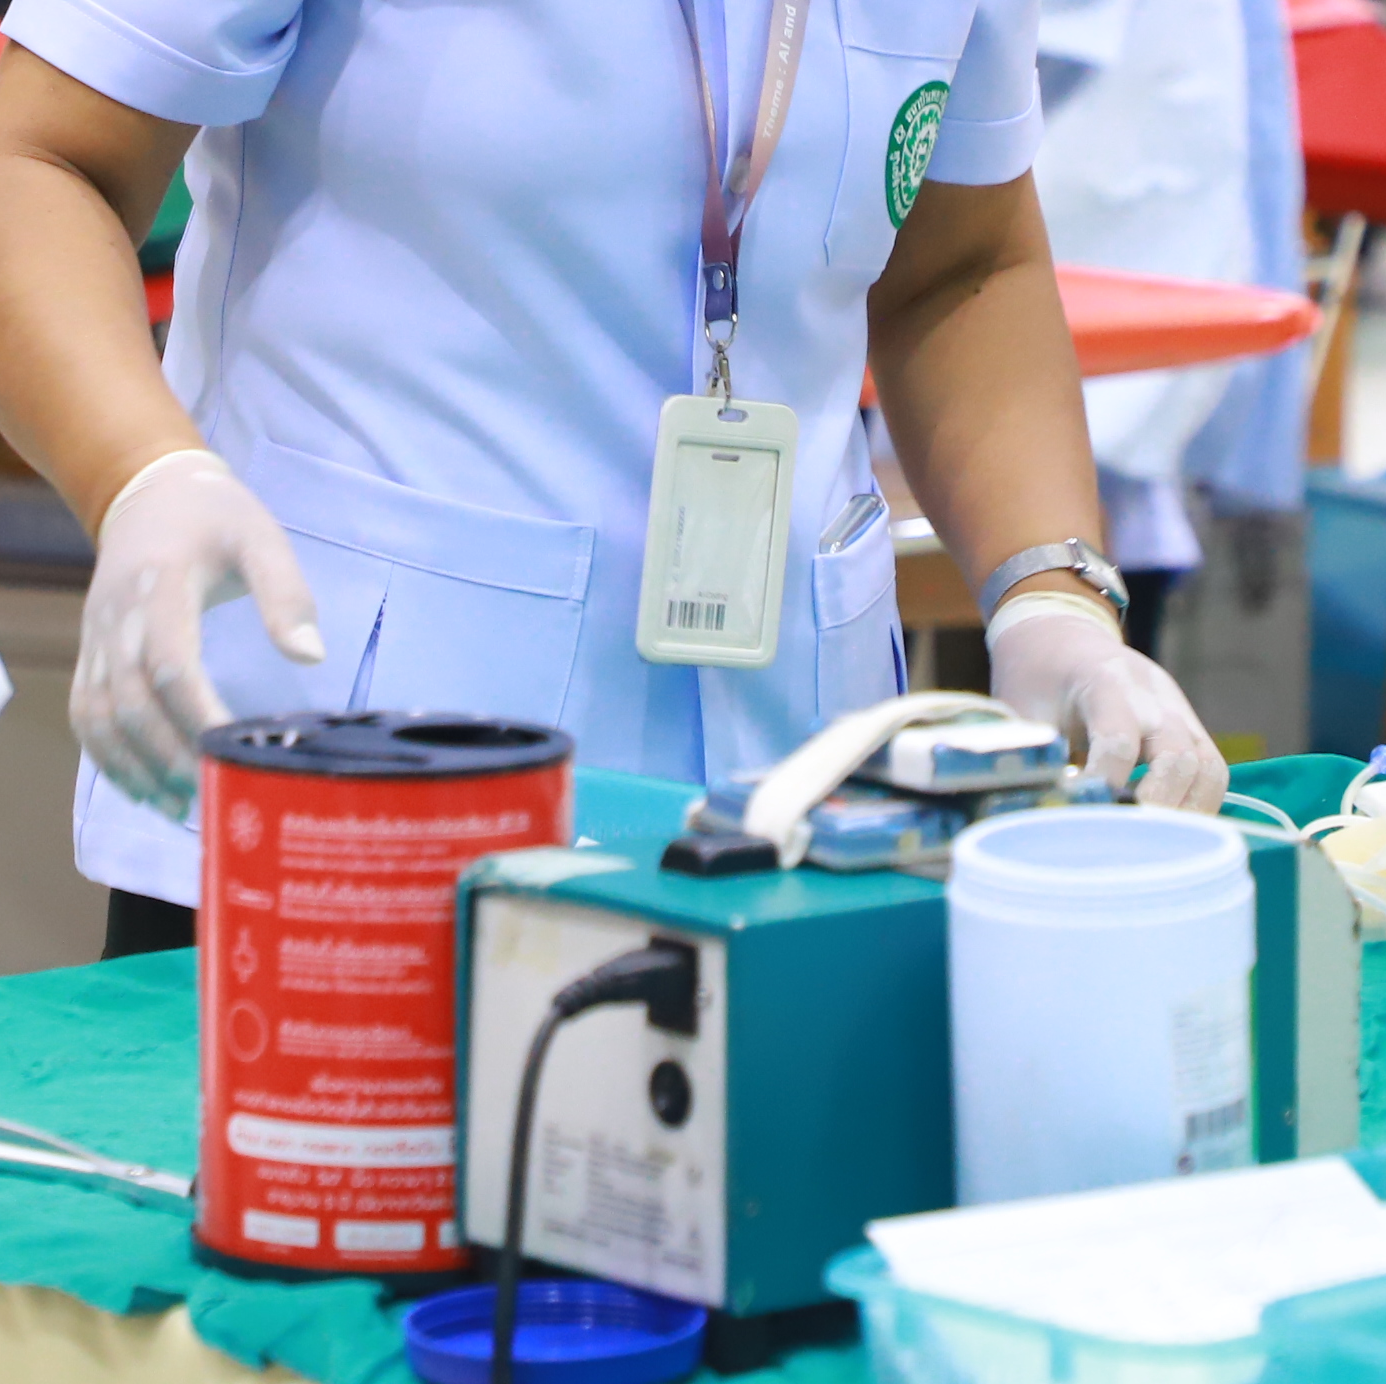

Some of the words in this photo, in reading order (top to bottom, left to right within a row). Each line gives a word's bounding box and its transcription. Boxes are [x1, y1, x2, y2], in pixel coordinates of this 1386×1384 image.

[784, 4, 798, 39] and
[778, 42, 791, 64] AI
[762, 79, 785, 138] Theme
